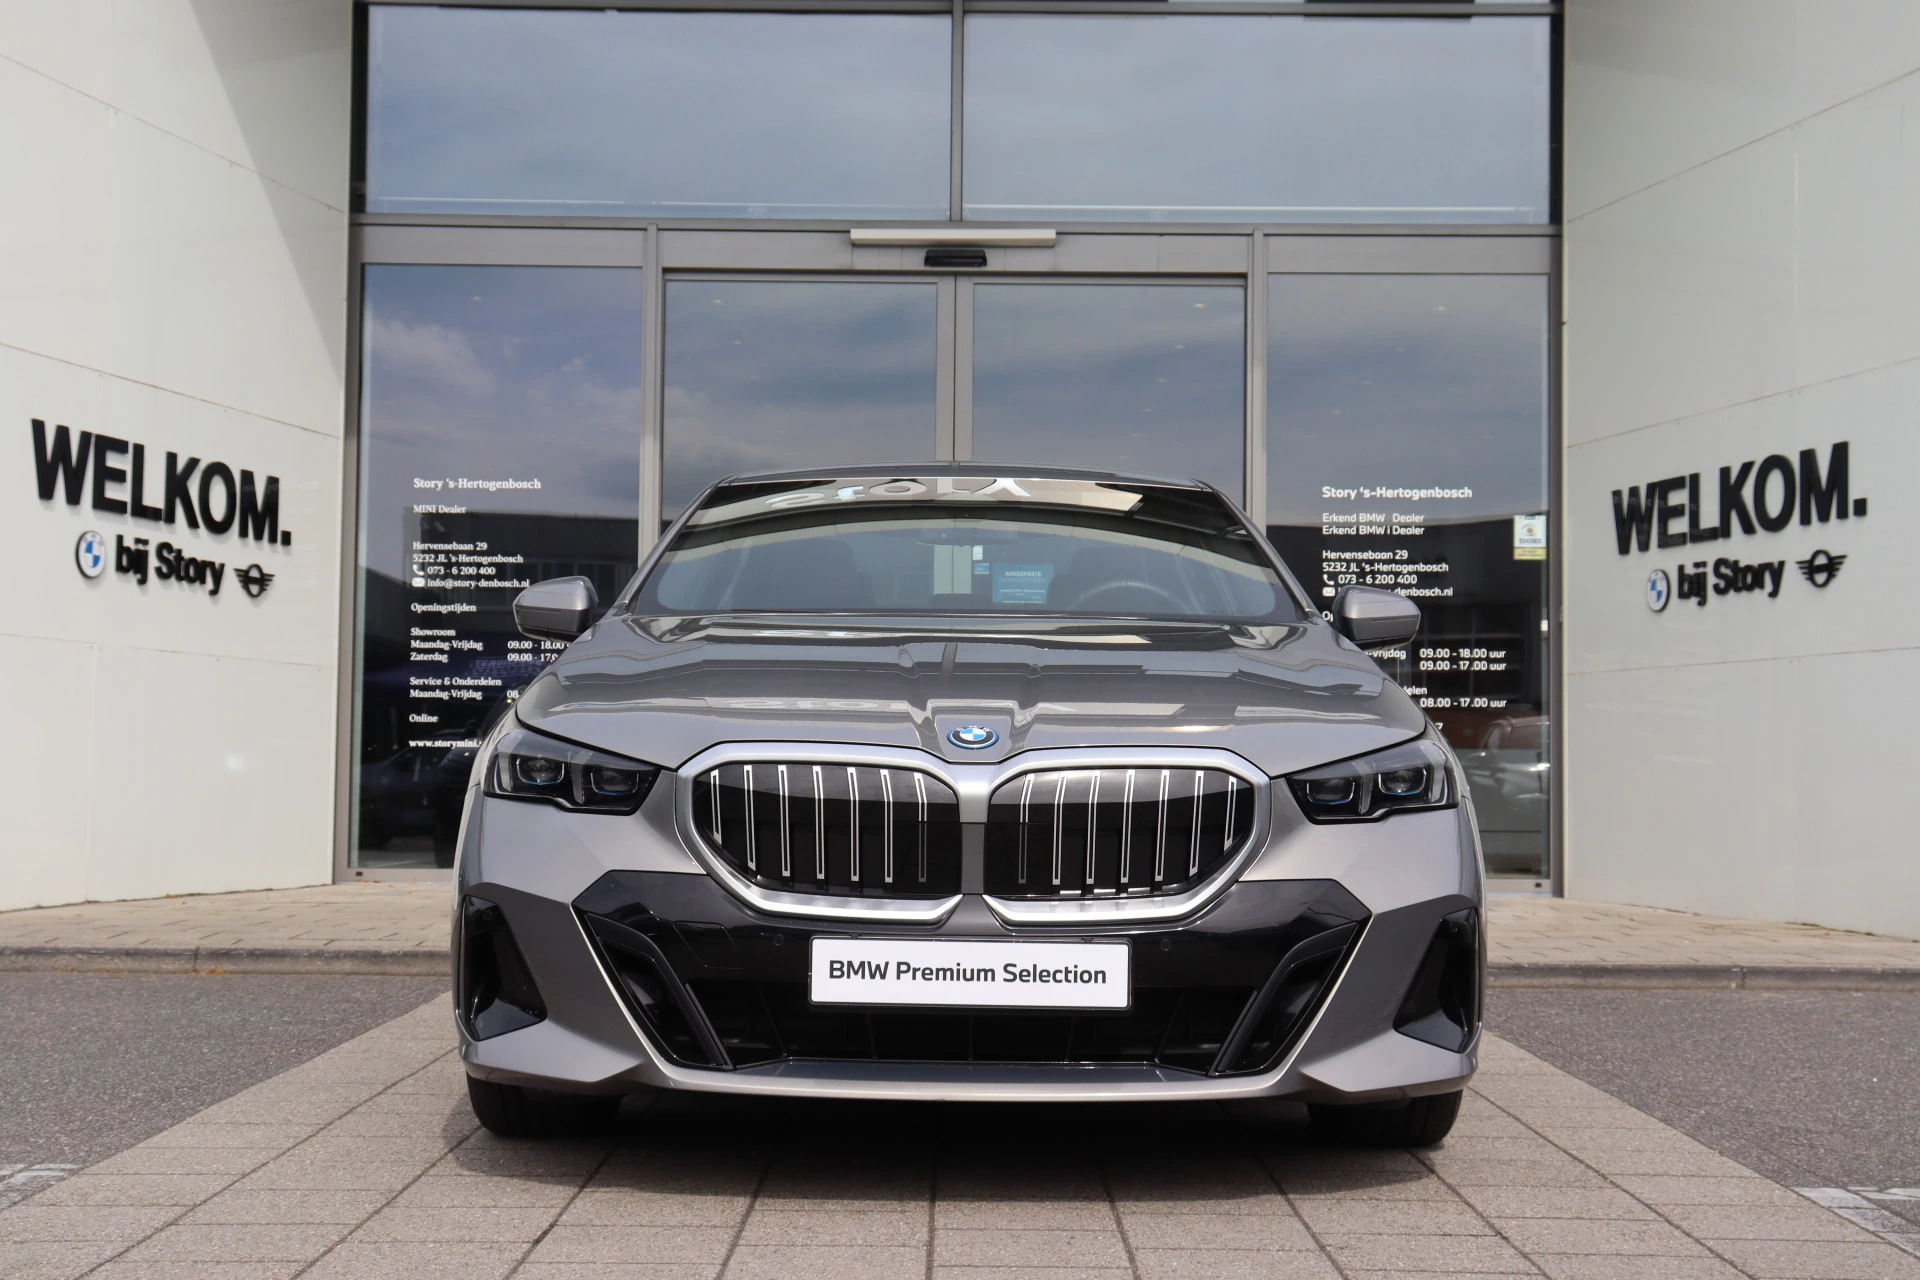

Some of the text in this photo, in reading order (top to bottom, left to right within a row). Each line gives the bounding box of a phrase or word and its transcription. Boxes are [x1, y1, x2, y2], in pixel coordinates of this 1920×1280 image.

[31, 418, 292, 546] WELKOM.
[413, 478, 444, 490] Story
[1322, 486, 1357, 499] Story
[1612, 441, 1867, 555] WELKOM.
[413, 505, 466, 513] MINI Dealer
[1322, 513, 1424, 523] Erkend BMW Dealer
[1322, 525, 1425, 535] Erkend BMW i Dealer
[412, 541, 487, 550] Hervensebaan 29
[412, 554, 435, 562] 5232
[436, 554, 448, 563] JL
[1322, 550, 1408, 559] Hervensebaan 29
[115, 533, 225, 596] bij Story
[1322, 562, 1347, 572] 5232
[1348, 563, 1360, 573] JL
[427, 567, 445, 575] 073
[451, 567, 458, 575] 6
[460, 567, 477, 575] 200
[478, 567, 496, 575] 400
[427, 578, 530, 589] info@story-denbosch.nl
[1338, 575, 1356, 584] 073
[1366, 575, 1373, 584] 6
[1375, 575, 1395, 584] 200
[1397, 575, 1417, 584] 400
[1677, 557, 1786, 607] bij Story
[411, 603, 477, 613] Openingstijden
[410, 627, 456, 636] Showroom
[410, 640, 483, 651] Maandag-Vrijdag
[507, 641, 533, 649] 09.00
[410, 652, 448, 663] Zaterdag
[507, 653, 533, 661] 09.00
[1366, 649, 1406, 660] -vrijdag
[1419, 648, 1450, 658] 09.00
[1459, 648, 1487, 658] 18.00
[1489, 650, 1506, 658] uur
[1419, 661, 1450, 671] 09.00
[1489, 662, 1506, 671] uur
[410, 677, 502, 686] Service & Onderdelen
[410, 690, 482, 700] Maandag-Vrijdag
[1419, 698, 1450, 708] 08.00
[1490, 699, 1507, 708] uur
[409, 713, 439, 723] Online
[828, 960, 1107, 985] BMW Premium Selection
